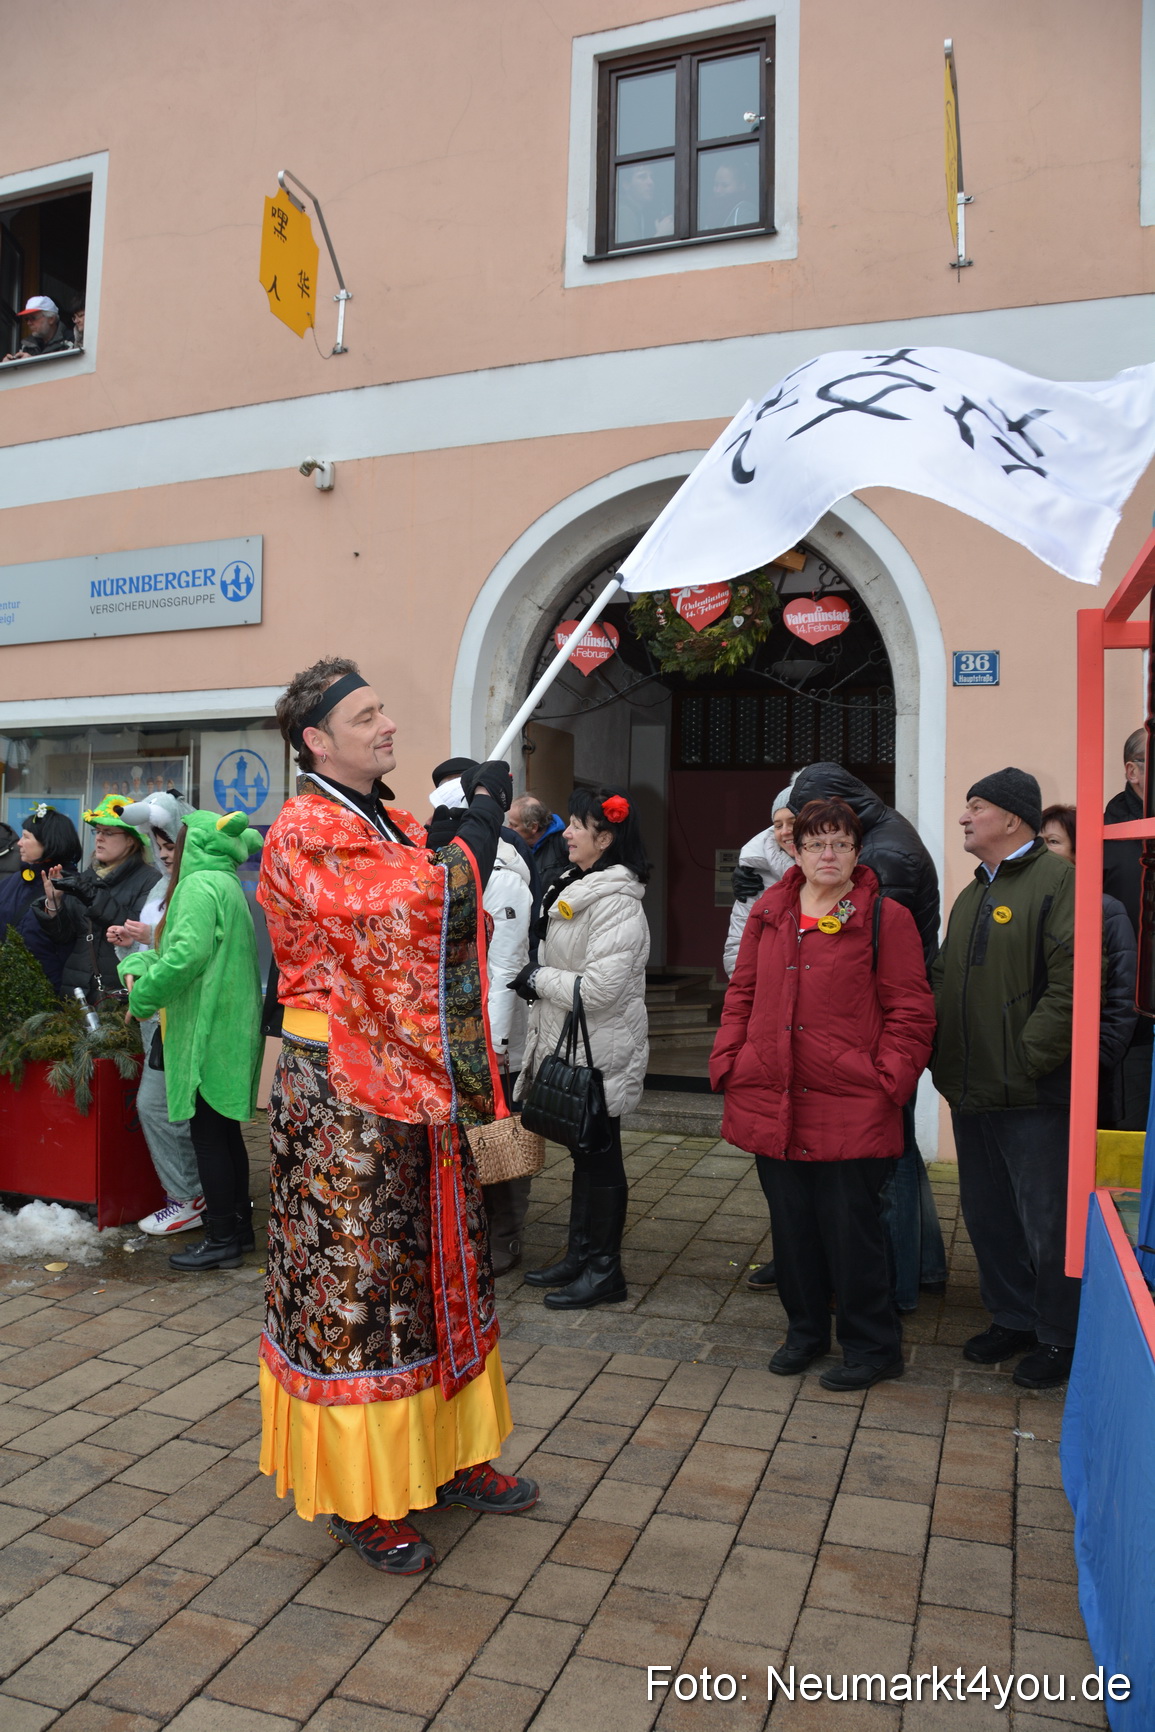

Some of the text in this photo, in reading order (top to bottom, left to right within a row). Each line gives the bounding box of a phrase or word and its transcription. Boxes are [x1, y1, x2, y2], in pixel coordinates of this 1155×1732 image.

[90, 568, 216, 598] NÜRNBERGER
[89, 594, 216, 615] VERSICHERUNGSGRUPPE
[682, 590, 730, 611] Valentinstag
[696, 598, 729, 615] Februar
[786, 606, 850, 626] Valentinstag
[960, 654, 990, 671] 36
[959, 674, 993, 683] Hauptstraße
